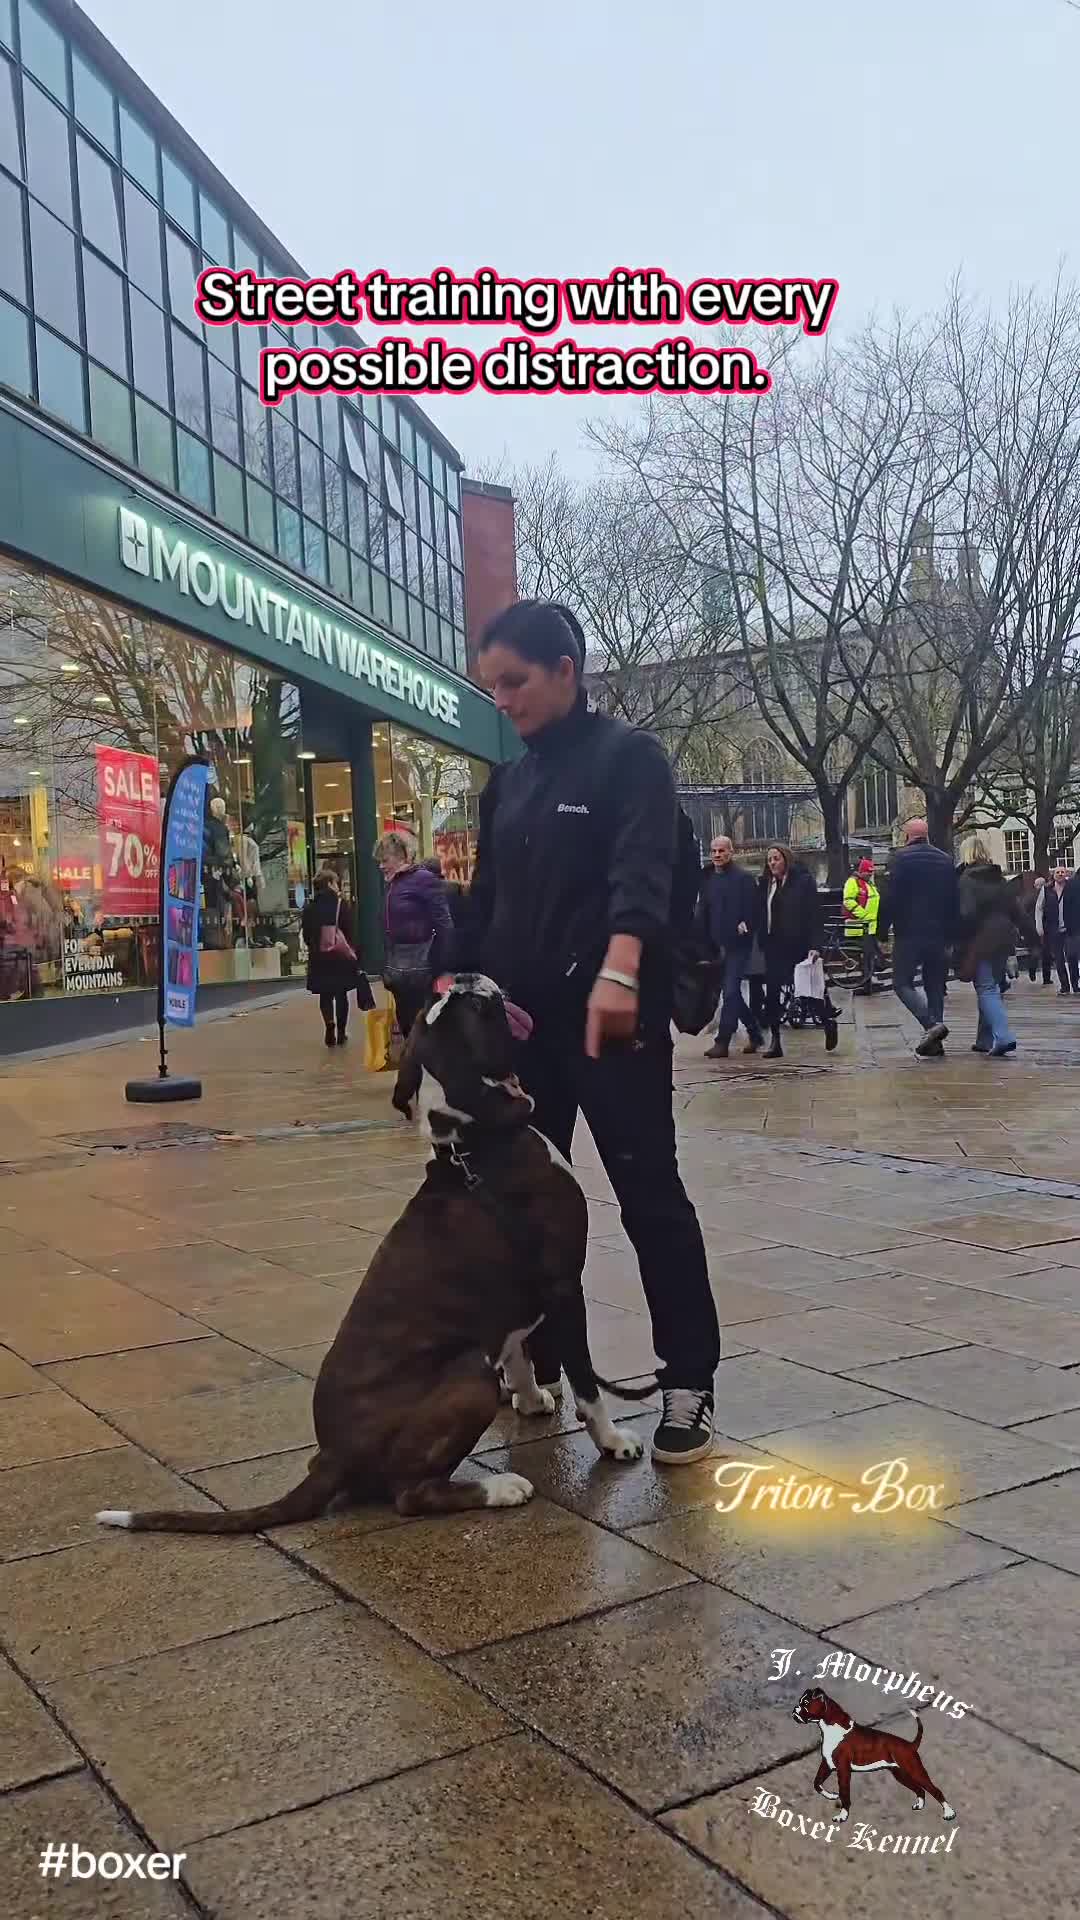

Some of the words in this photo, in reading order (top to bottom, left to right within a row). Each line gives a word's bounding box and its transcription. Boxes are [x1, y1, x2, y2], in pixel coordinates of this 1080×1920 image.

[152, 525, 334, 664] MOUNTAIN
[333, 627, 462, 729] WAREHOUSE
[103, 765, 155, 802] SALE
[556, 802, 591, 815] Bench.
[53, 866, 92, 880] SALE
[65, 954, 115, 972] EVERYDAY
[66, 971, 123, 991] MOUNTAINS
